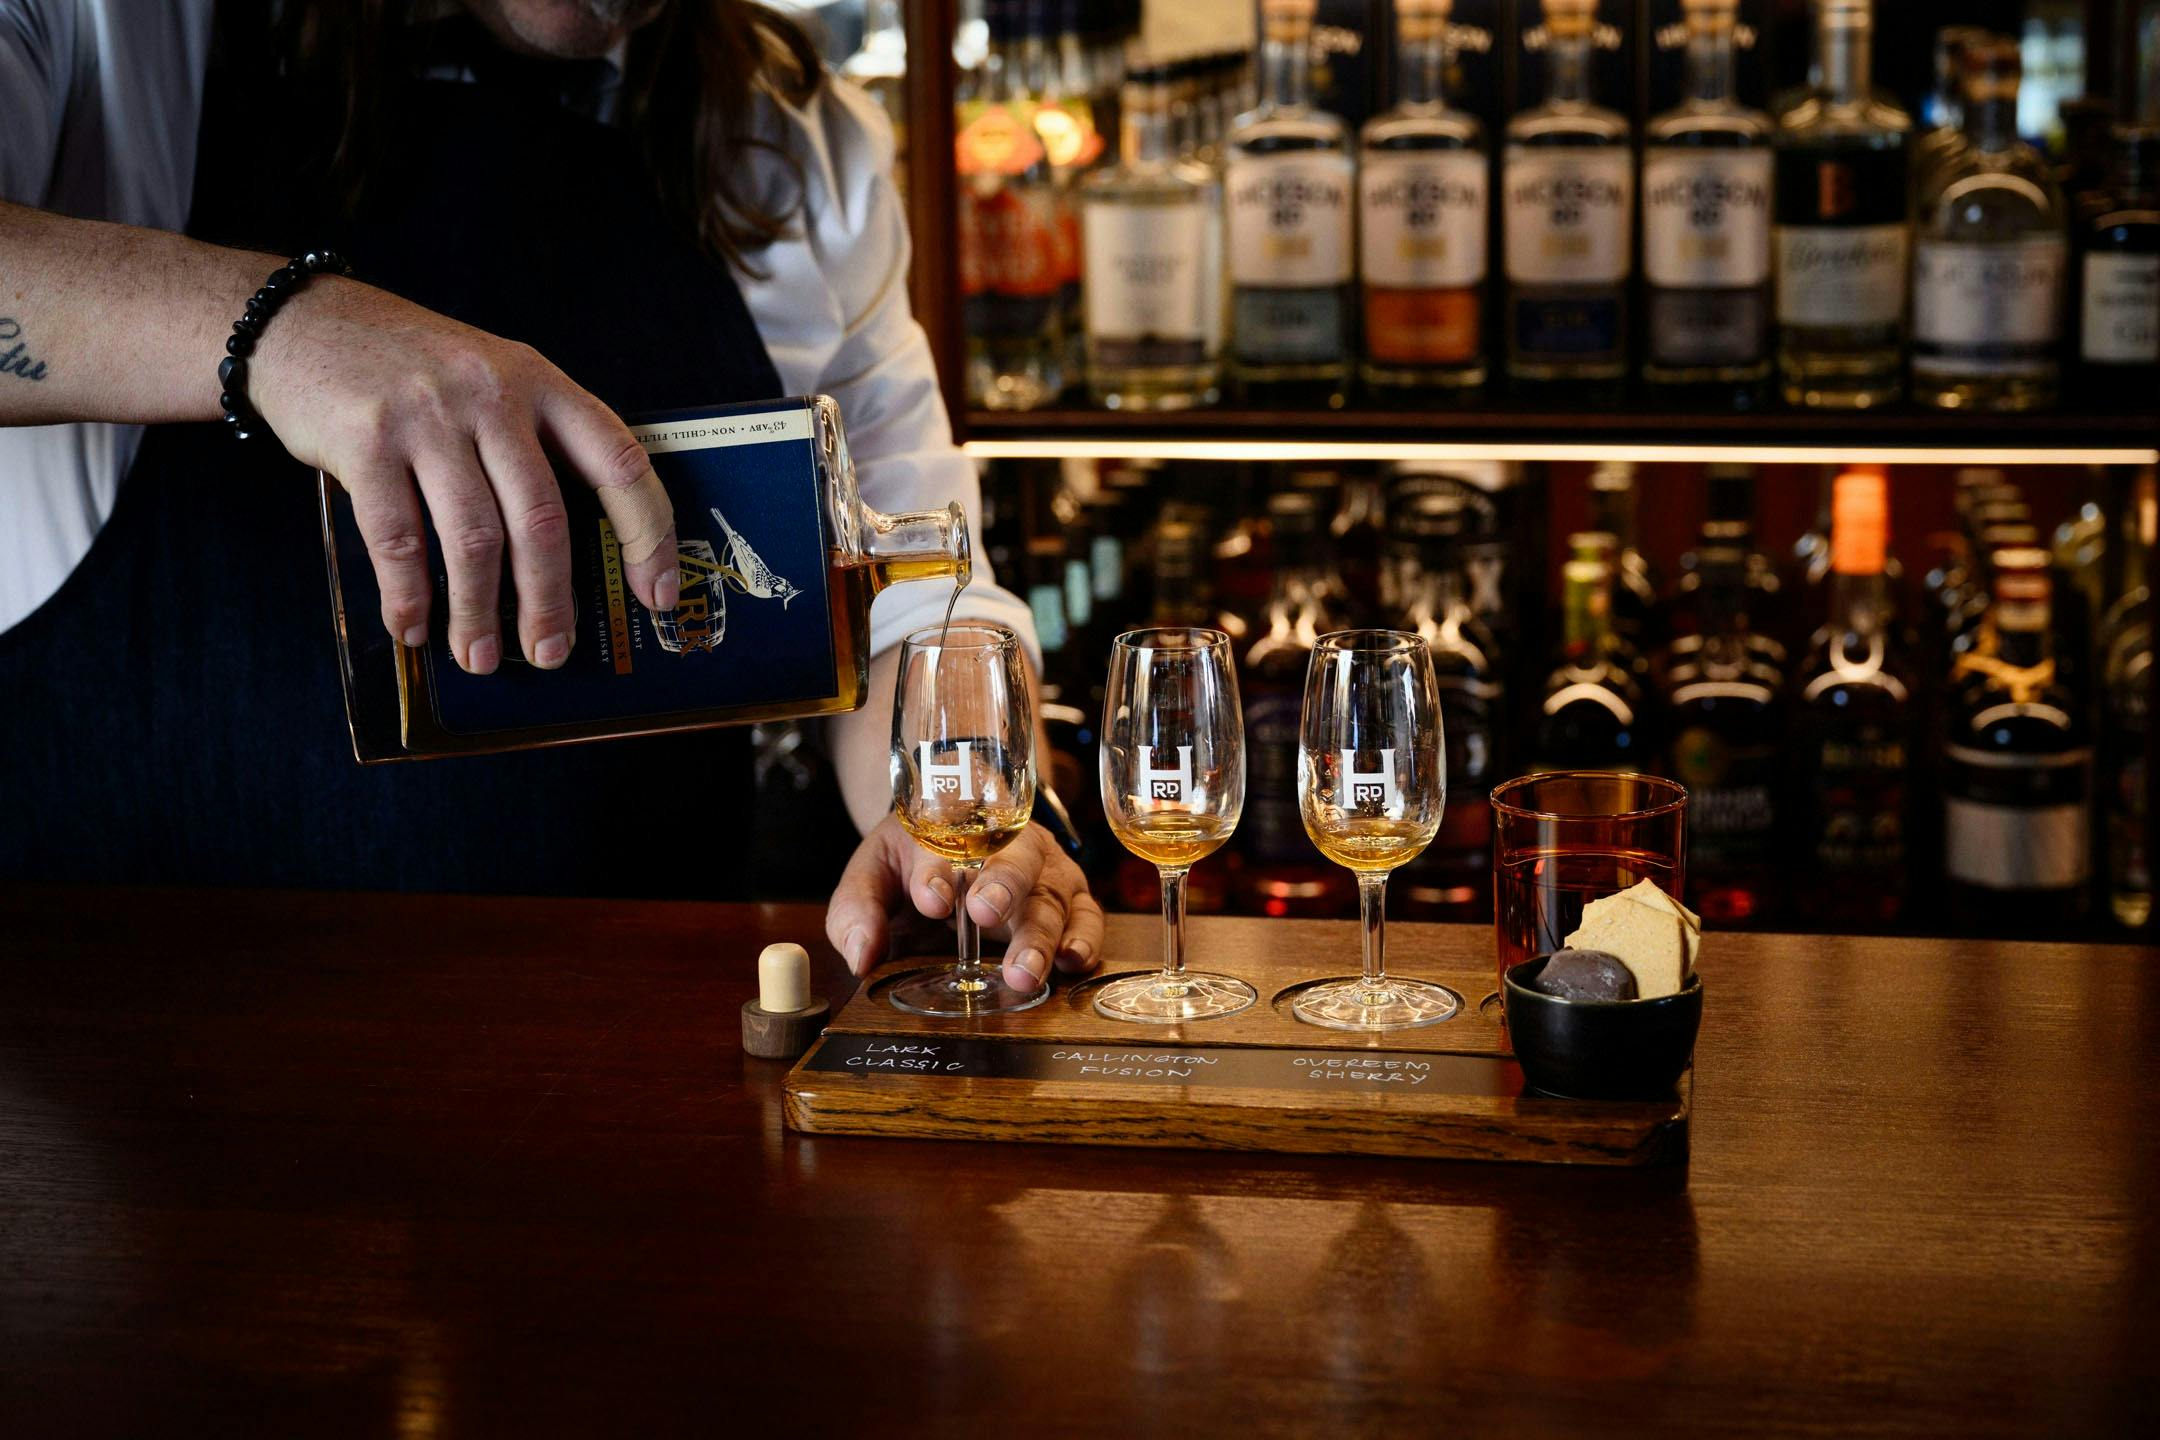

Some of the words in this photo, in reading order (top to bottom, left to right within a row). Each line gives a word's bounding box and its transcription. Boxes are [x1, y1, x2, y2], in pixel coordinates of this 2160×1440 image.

[671, 427, 736, 440] NON-CHILL
[604, 530, 621, 607] CLASSIC
[613, 618, 627, 660] CASK
[632, 618, 643, 650] FIRST
[919, 741, 975, 800] H
[1138, 746, 1193, 804] H
[1340, 749, 1397, 809] H
[865, 1043, 941, 1055] LARK
[846, 1056, 965, 1071] CLASSIC
[1052, 1051, 1218, 1065] CALLINGTON
[1292, 1058, 1431, 1071] OVEREEM
[1080, 1066, 1192, 1077] FUSION
[1309, 1069, 1427, 1085] SHERRY
